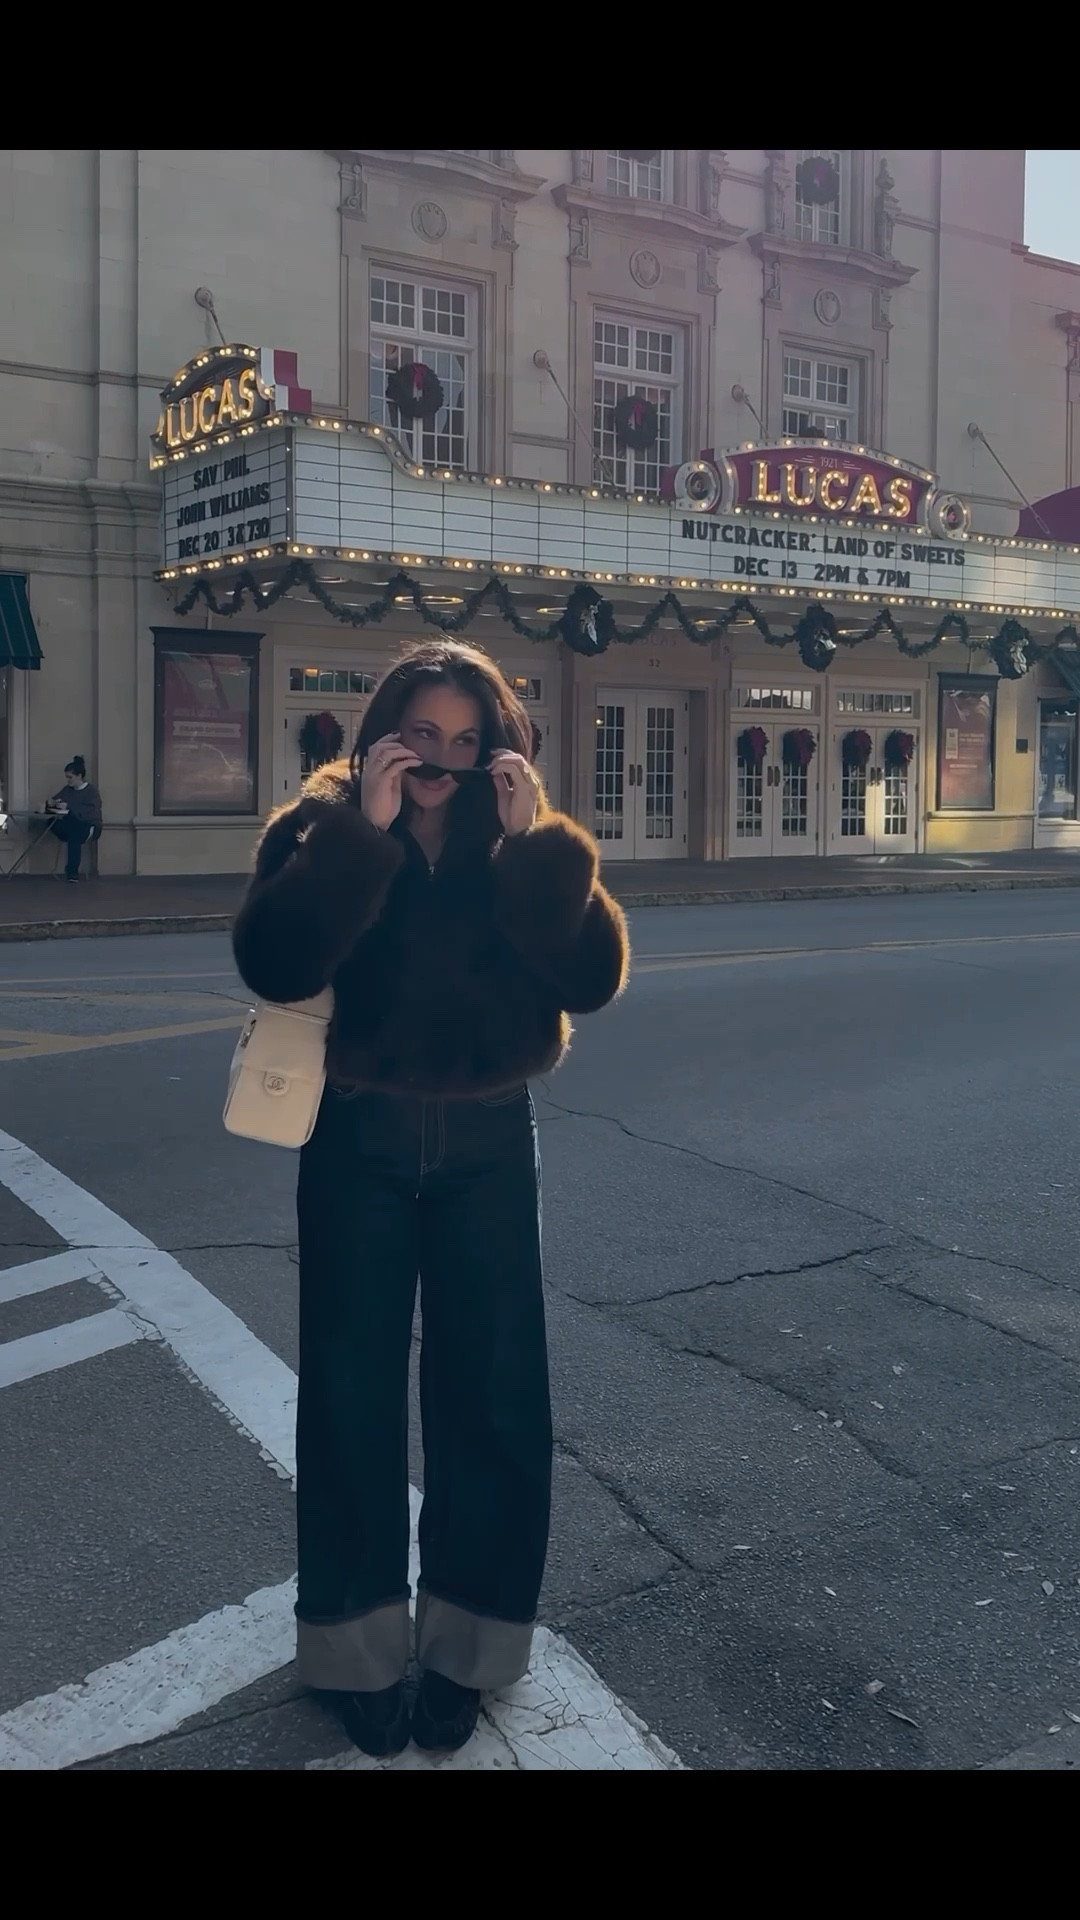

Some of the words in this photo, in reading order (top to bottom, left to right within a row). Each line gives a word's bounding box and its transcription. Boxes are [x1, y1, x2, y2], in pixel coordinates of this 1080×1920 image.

[167, 368, 255, 447] LUCAS
[193, 464, 218, 490] SAV
[224, 454, 250, 481] PHIL
[820, 456, 838, 469] 1921
[177, 501, 206, 527] JOHN
[210, 482, 270, 518] WILLIAMS
[752, 459, 912, 518] LUCAS
[179, 535, 200, 558] DEC
[204, 530, 219, 552] 20
[682, 519, 817, 553] NUTCRACKER:
[823, 534, 868, 558] LAND
[873, 540, 894, 559] OF
[901, 544, 965, 566] SWEETS
[733, 556, 769, 577] DEC
[781, 560, 798, 578] 13
[814, 563, 850, 584] 2PM
[857, 567, 869, 585] &
[877, 569, 911, 588] 7PM
